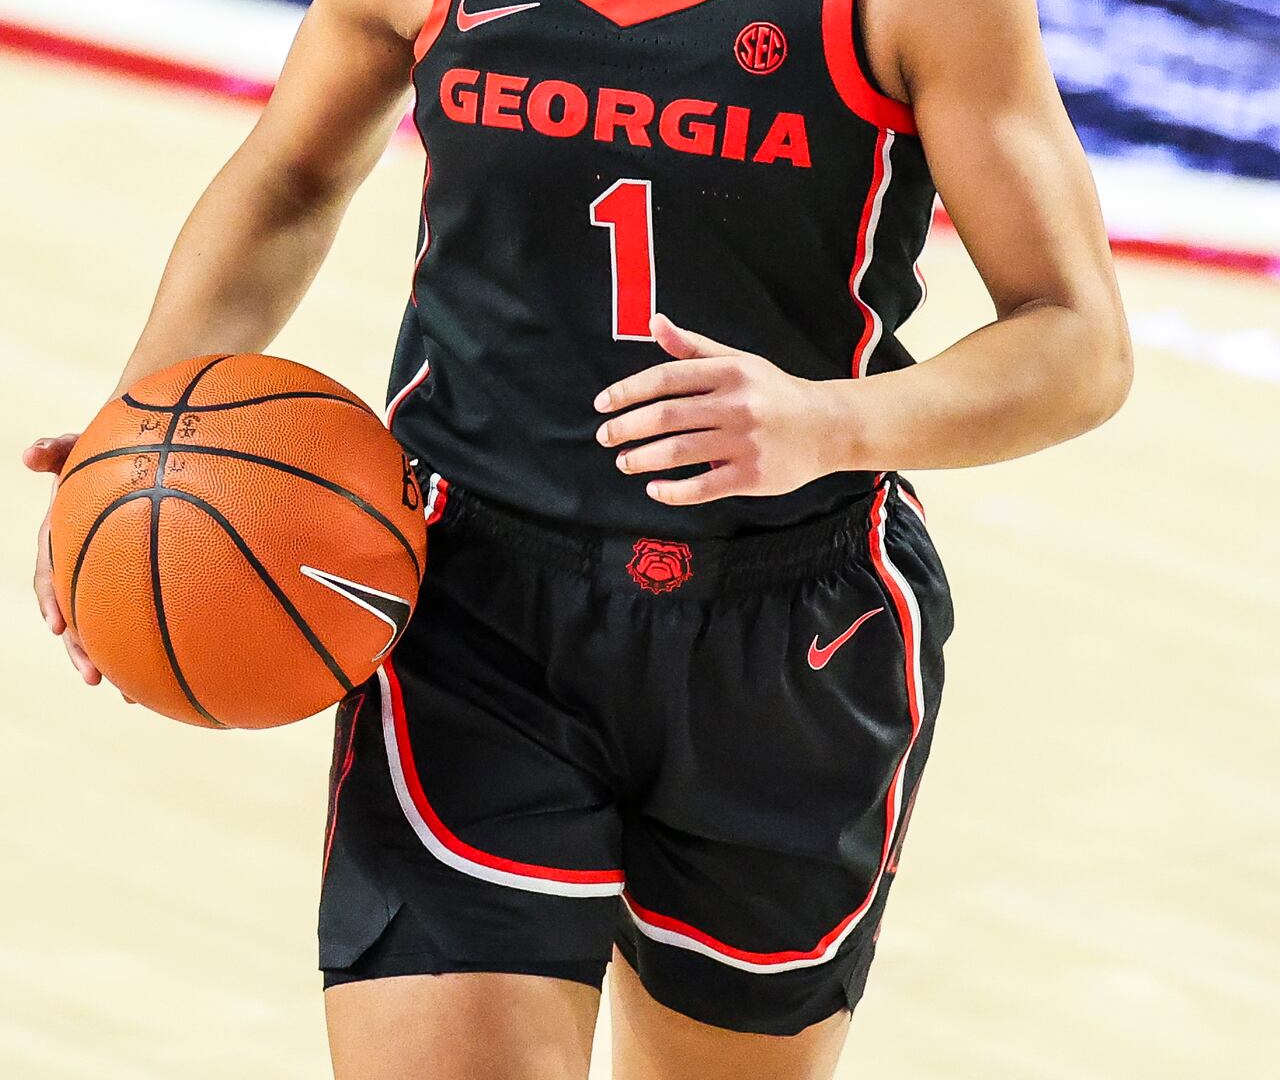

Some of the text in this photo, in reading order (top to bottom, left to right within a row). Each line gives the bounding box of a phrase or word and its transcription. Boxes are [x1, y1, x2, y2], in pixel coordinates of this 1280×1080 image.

[739, 25, 782, 70] SEC
[439, 68, 813, 169] GEORGIA
[589, 177, 657, 342] 1
